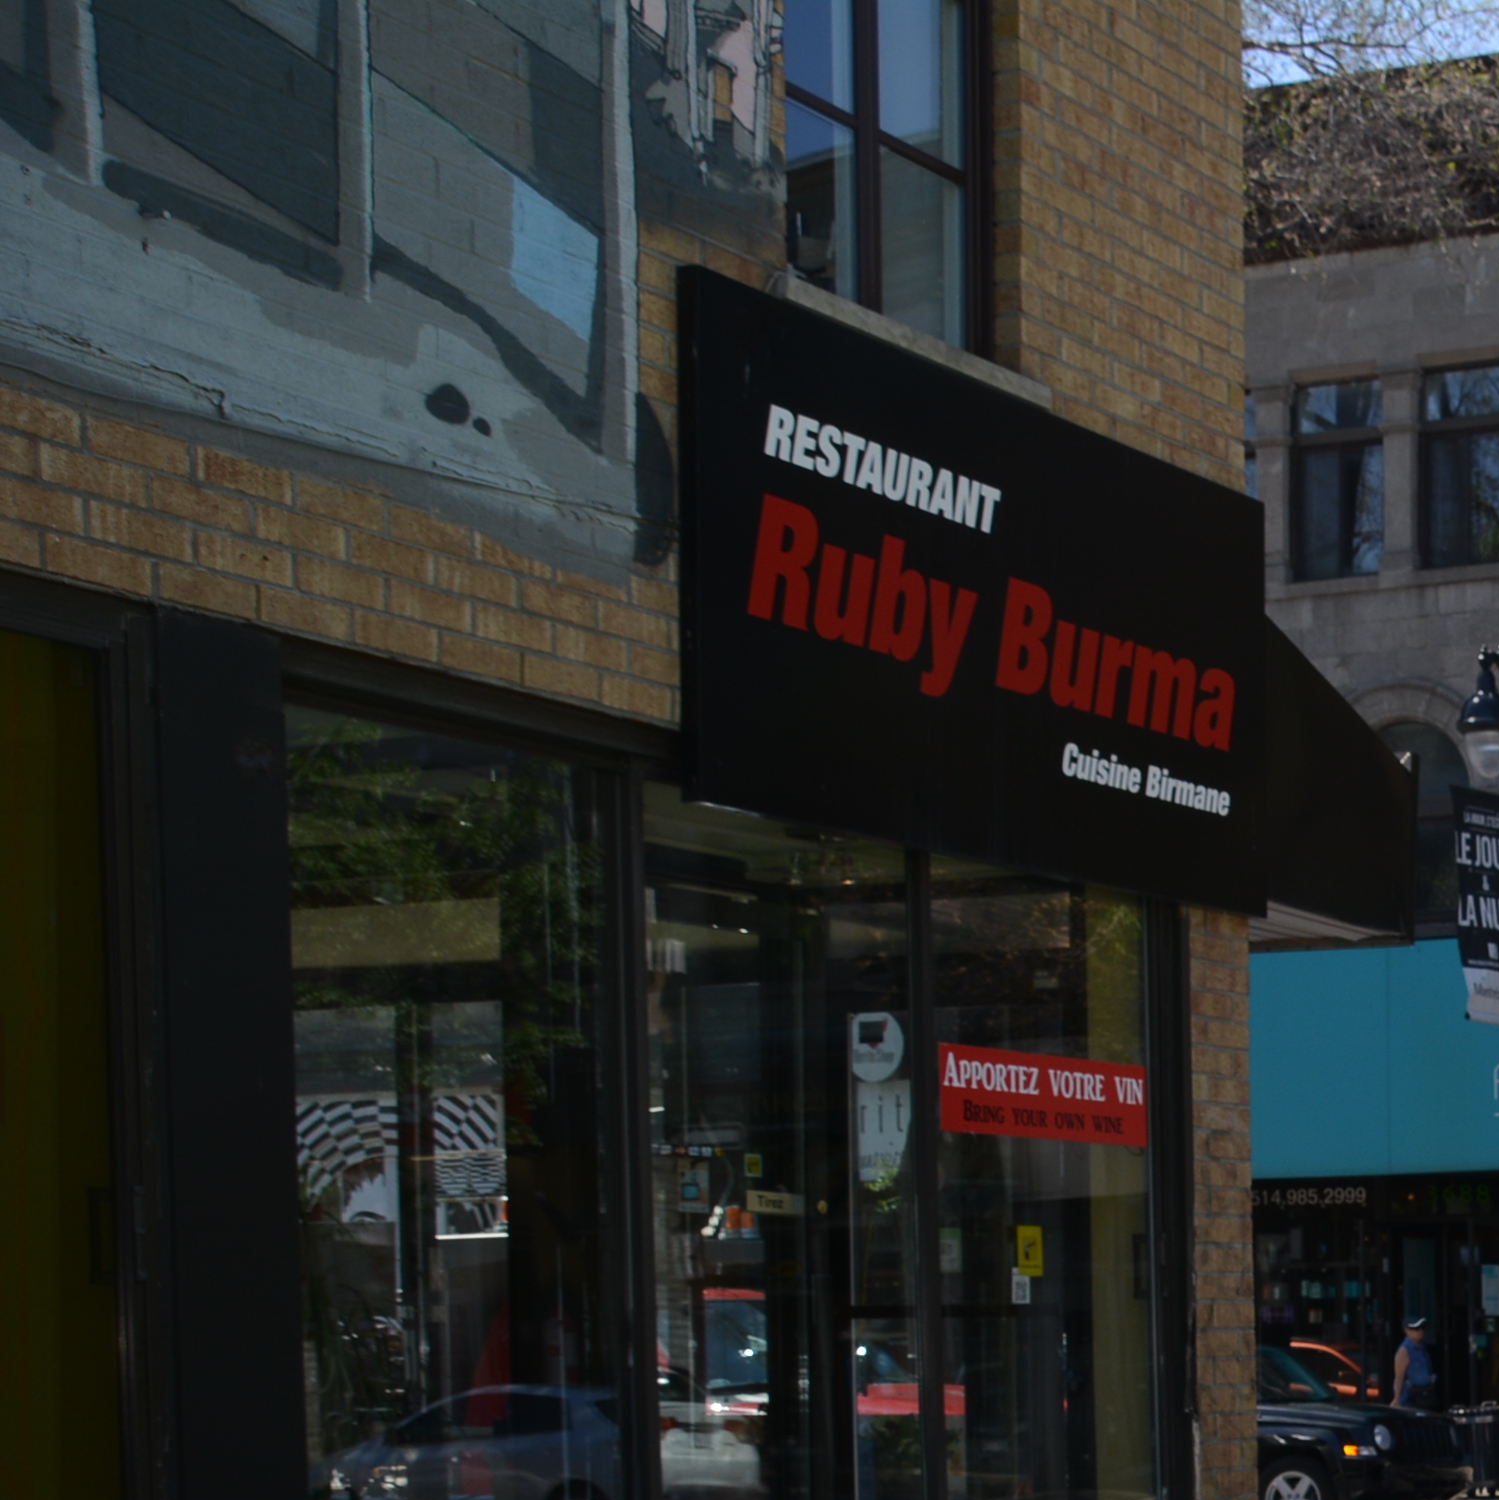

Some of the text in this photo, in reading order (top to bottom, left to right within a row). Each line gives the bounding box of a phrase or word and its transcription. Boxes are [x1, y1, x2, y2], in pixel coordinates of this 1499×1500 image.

[763, 404, 1002, 535] RESTAURANT
[746, 493, 1236, 752] Ruby Burma
[1061, 742, 1231, 817] Cuisine Birmane
[1454, 830, 1473, 866] LE
[1457, 893, 1478, 928] LA
[942, 1051, 1144, 1106] APPORTEZ VOTRE VIN
[962, 1100, 1125, 1135] BRING YOUR OWN WINE
[1251, 1186, 1368, 1209] 514.985.2999
